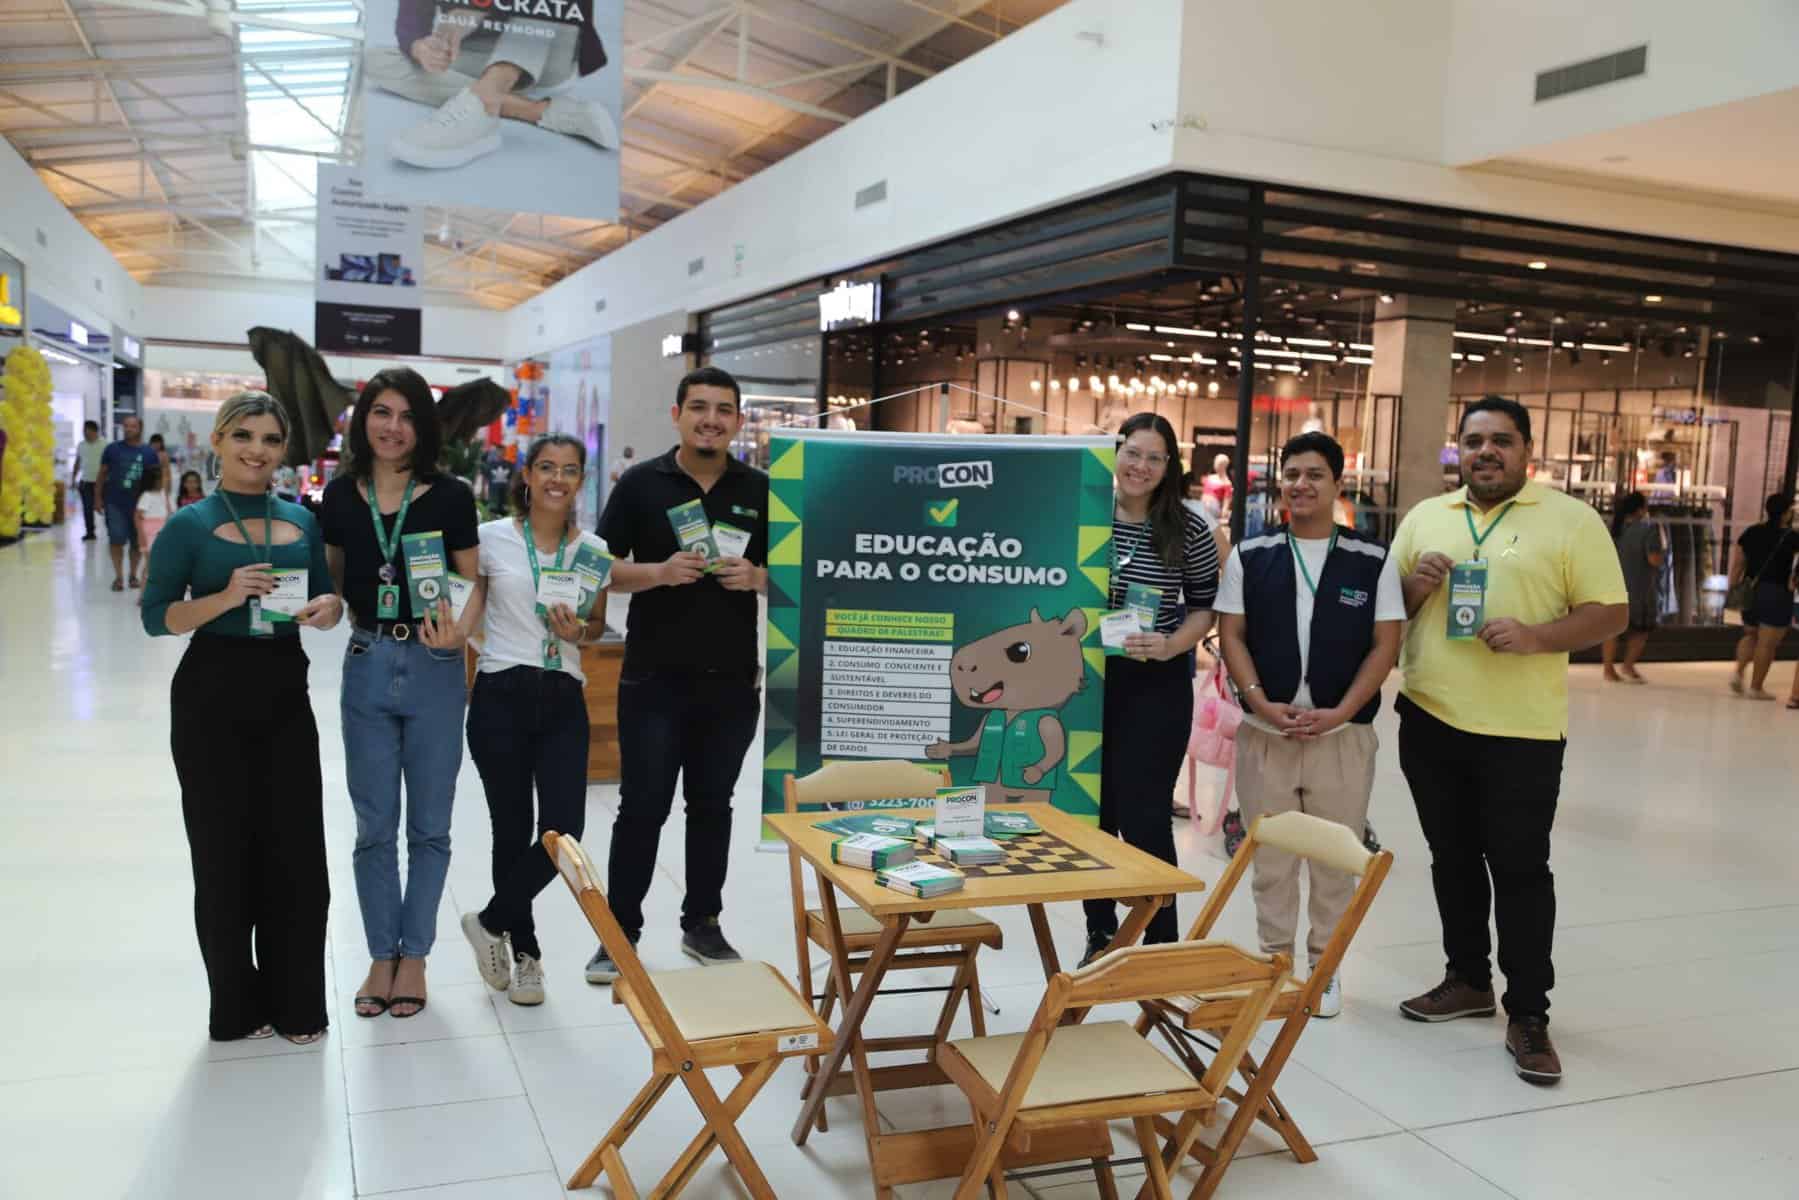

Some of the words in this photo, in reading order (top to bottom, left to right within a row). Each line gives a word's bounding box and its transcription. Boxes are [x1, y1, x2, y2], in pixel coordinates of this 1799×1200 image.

[893, 463, 989, 485] PROCON
[855, 532, 1022, 562] EDUCAÇÃO
[816, 559, 892, 580] PARA
[900, 563, 921, 581] O
[928, 563, 1068, 586] CONSUMO
[872, 615, 912, 623] CONHECE
[914, 616, 946, 624] NOSSO
[839, 644, 883, 655] EDUCAÇÃO
[885, 647, 935, 655] FINANCEIRA
[838, 660, 880, 669] CONSUMO
[884, 662, 935, 671] CONSCIENTE
[837, 689, 873, 697] DIREITOS
[882, 691, 917, 699] DEVERES
[828, 702, 884, 711] CONSUMIDOR
[836, 716, 931, 727] SUPERENDIVIDAMENTO
[850, 731, 875, 739] GERAL
[890, 732, 933, 742] PROTEÇÃO
[839, 744, 867, 752] DADOS
